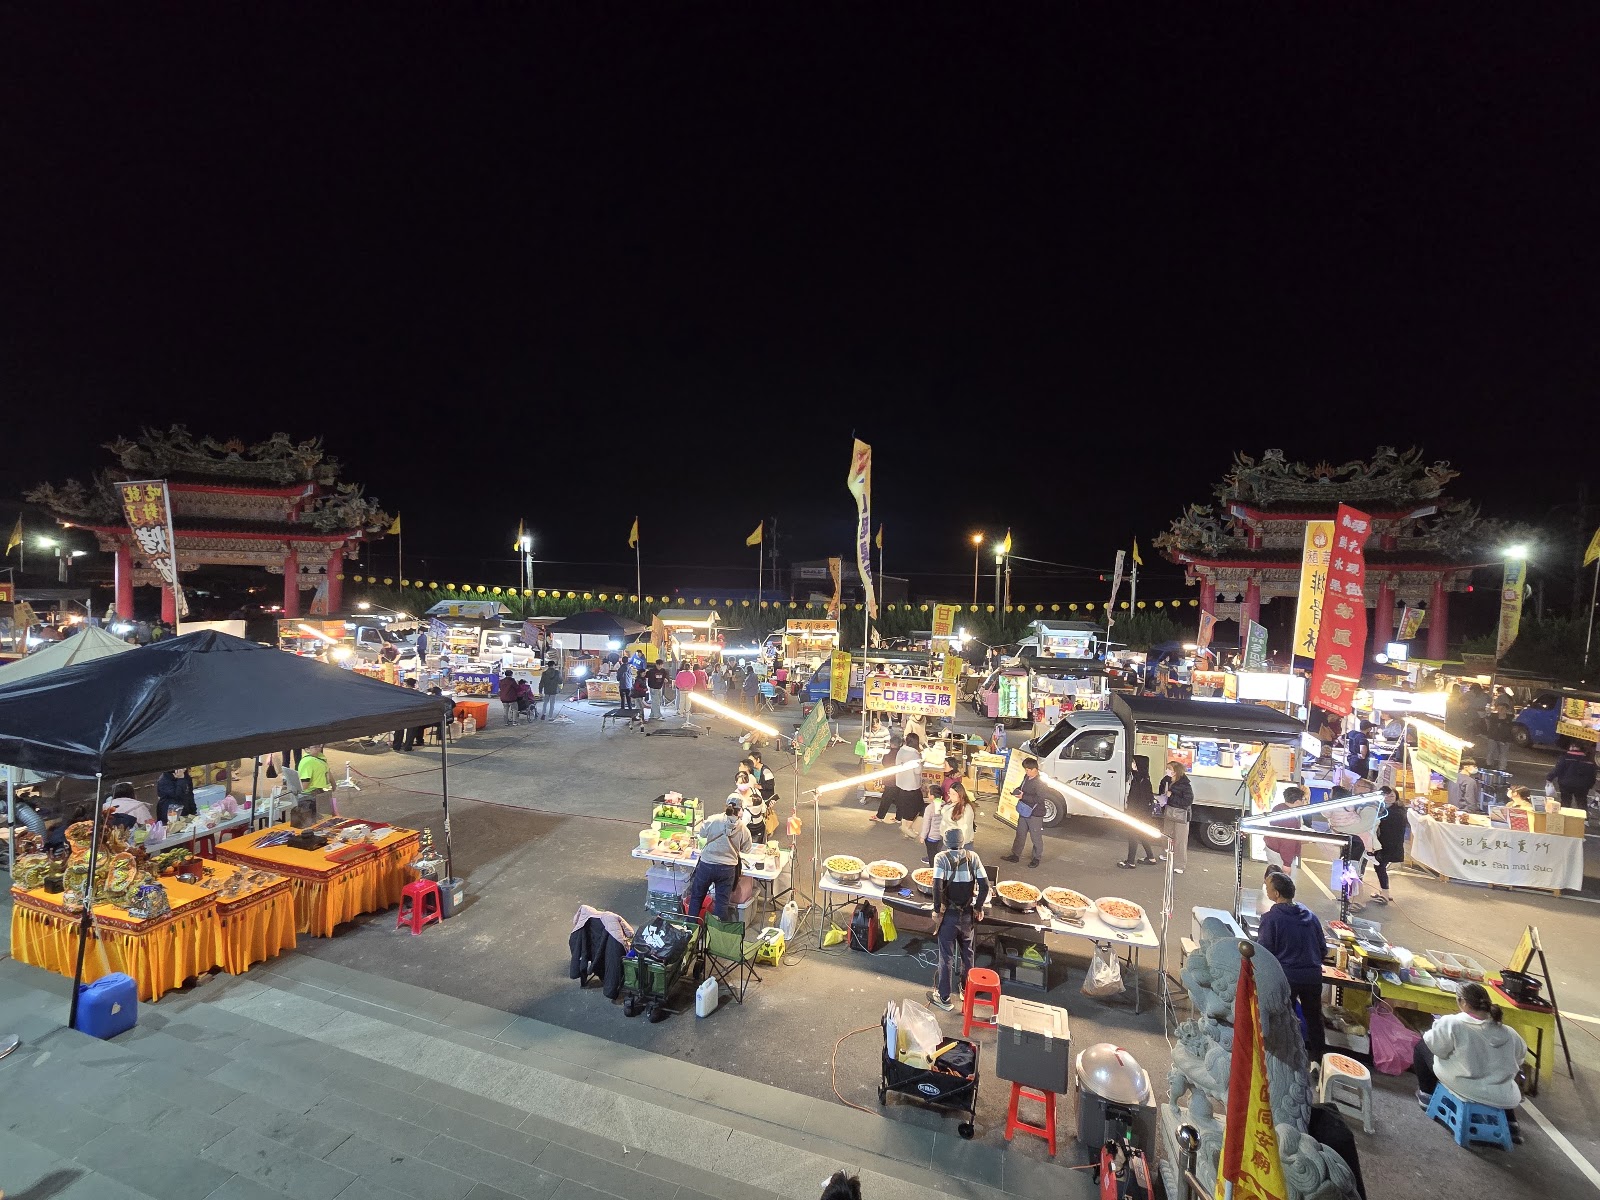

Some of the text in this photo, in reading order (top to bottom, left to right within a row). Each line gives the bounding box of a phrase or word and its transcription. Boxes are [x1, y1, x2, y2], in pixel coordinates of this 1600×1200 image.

[869, 689, 952, 706] 一口酥臭豆腐
[1512, 863, 1531, 871] mai
